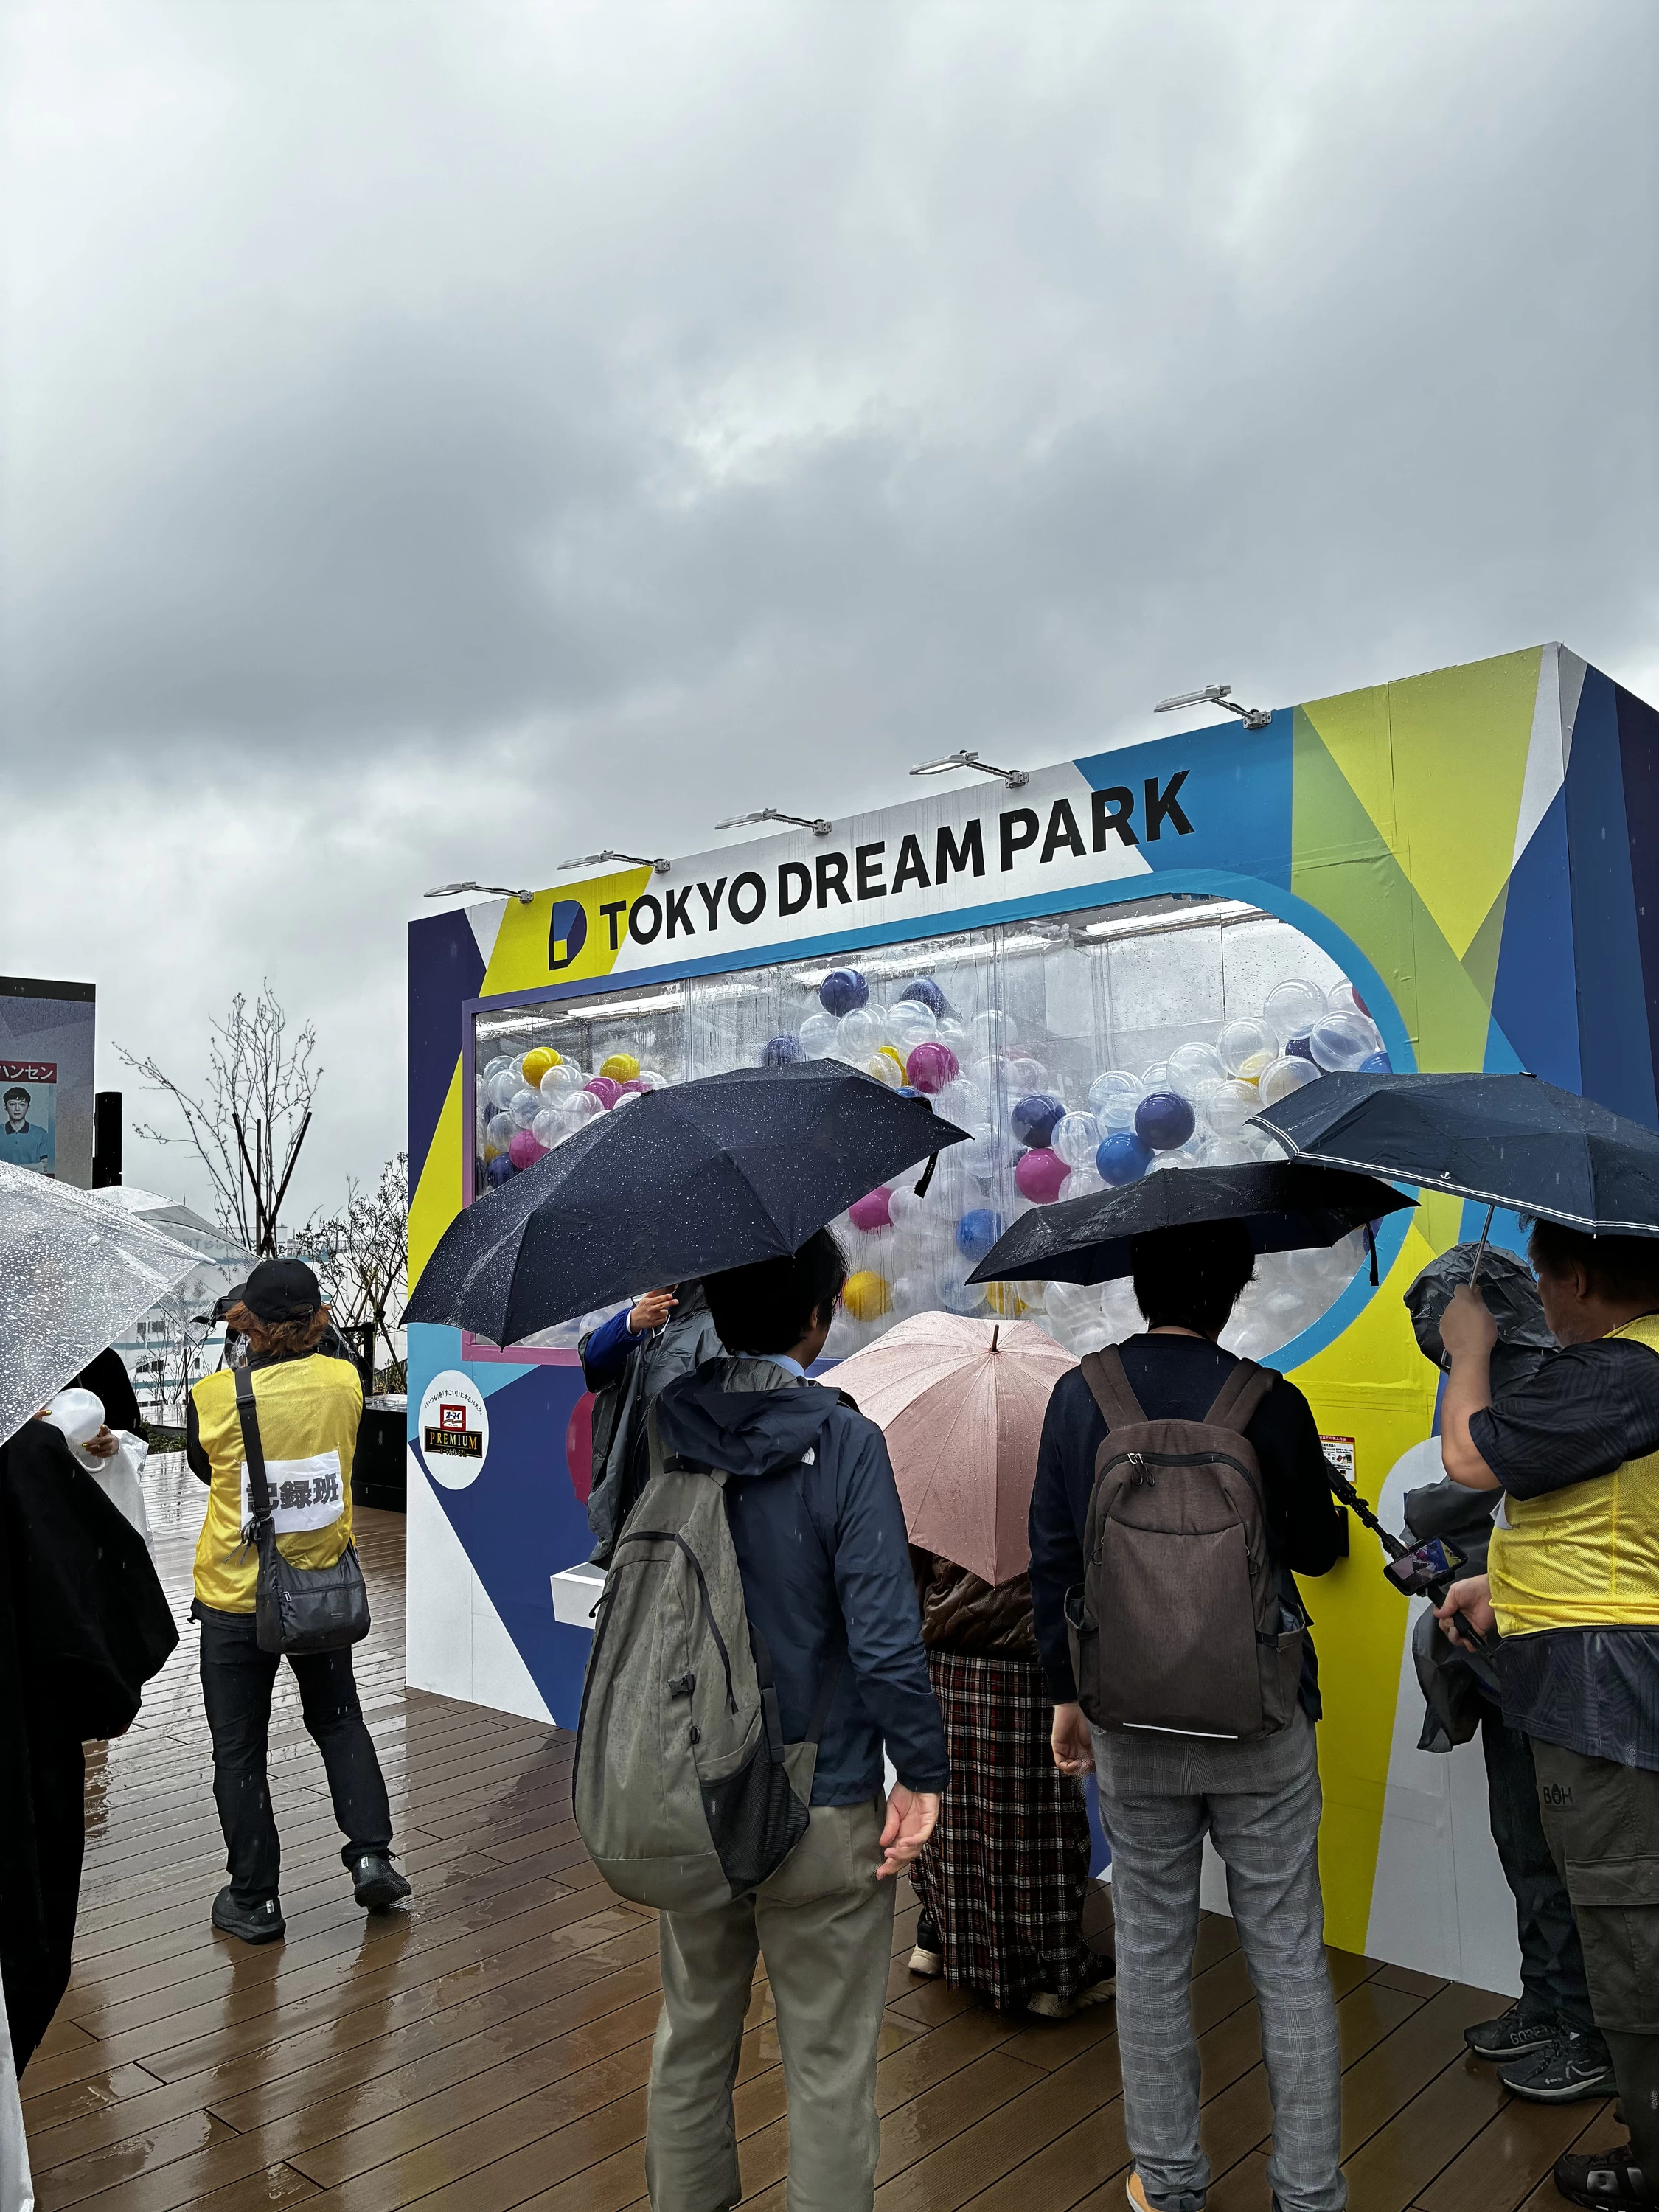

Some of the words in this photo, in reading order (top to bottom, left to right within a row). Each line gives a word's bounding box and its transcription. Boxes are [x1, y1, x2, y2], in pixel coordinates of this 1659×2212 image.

[599, 871, 767, 951] TOKYO
[777, 818, 986, 917] DREAM
[998, 768, 1195, 872] PARK
[430, 1432, 477, 1450] PREMIUM
